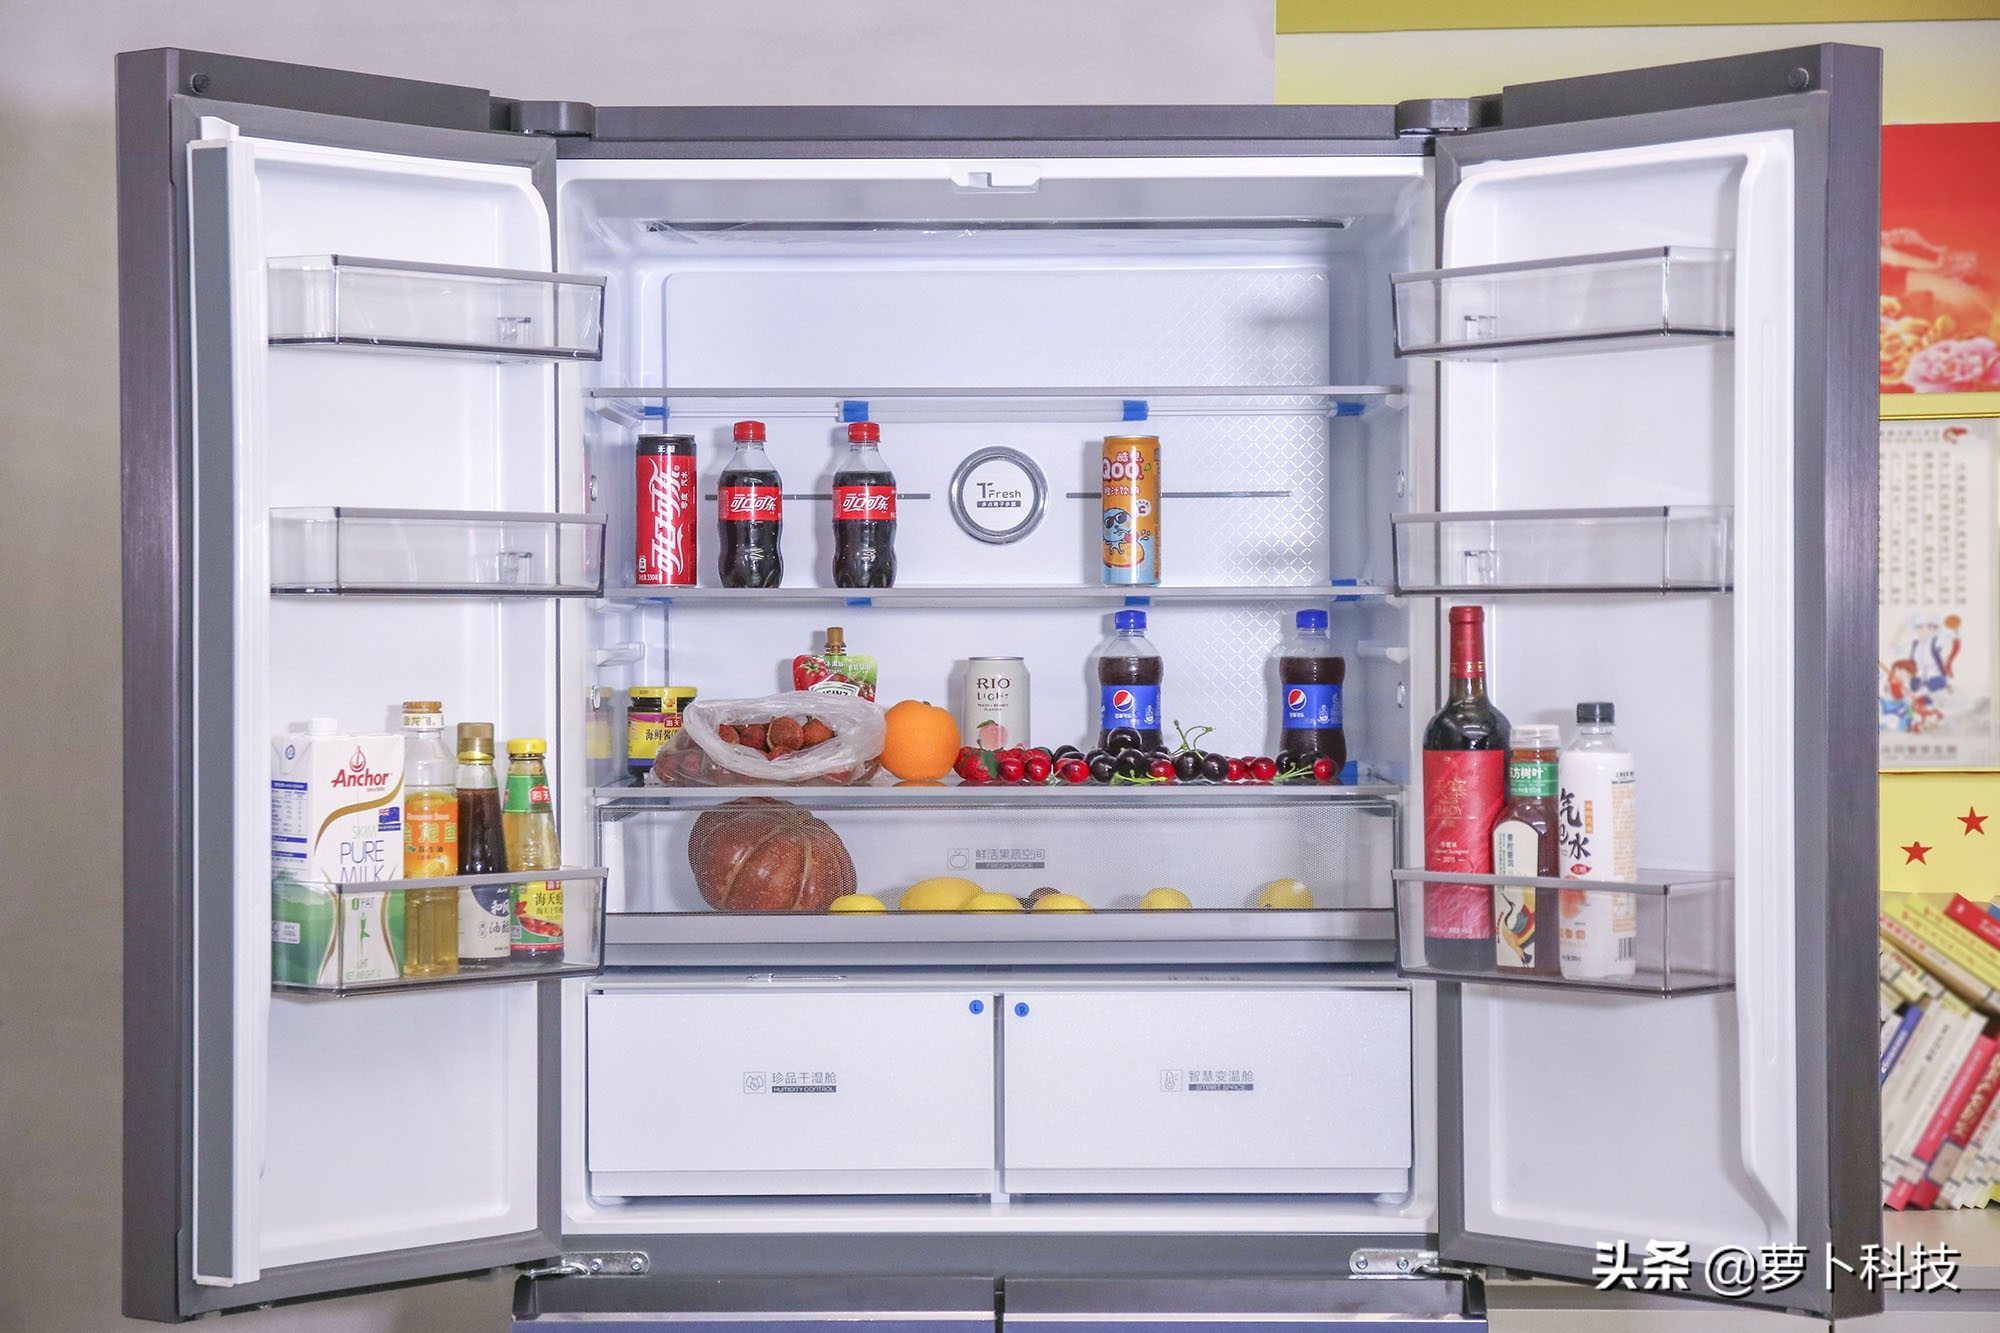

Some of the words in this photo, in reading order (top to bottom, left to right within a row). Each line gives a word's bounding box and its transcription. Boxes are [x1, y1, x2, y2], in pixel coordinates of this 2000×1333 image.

[730, 496, 777, 512] 可口可乐
[842, 495, 889, 512] 可口可乐
[976, 677, 1011, 690] RIO
[330, 768, 389, 788] Anchor
[340, 840, 385, 864] PURE
[975, 848, 1045, 860] 鲜活果蔬空间
[973, 1003, 980, 1012] L
[1019, 1006, 1027, 1015] R
[772, 1071, 837, 1084] 珍品干湿舱
[1188, 1069, 1254, 1082] 智慧变温舱
